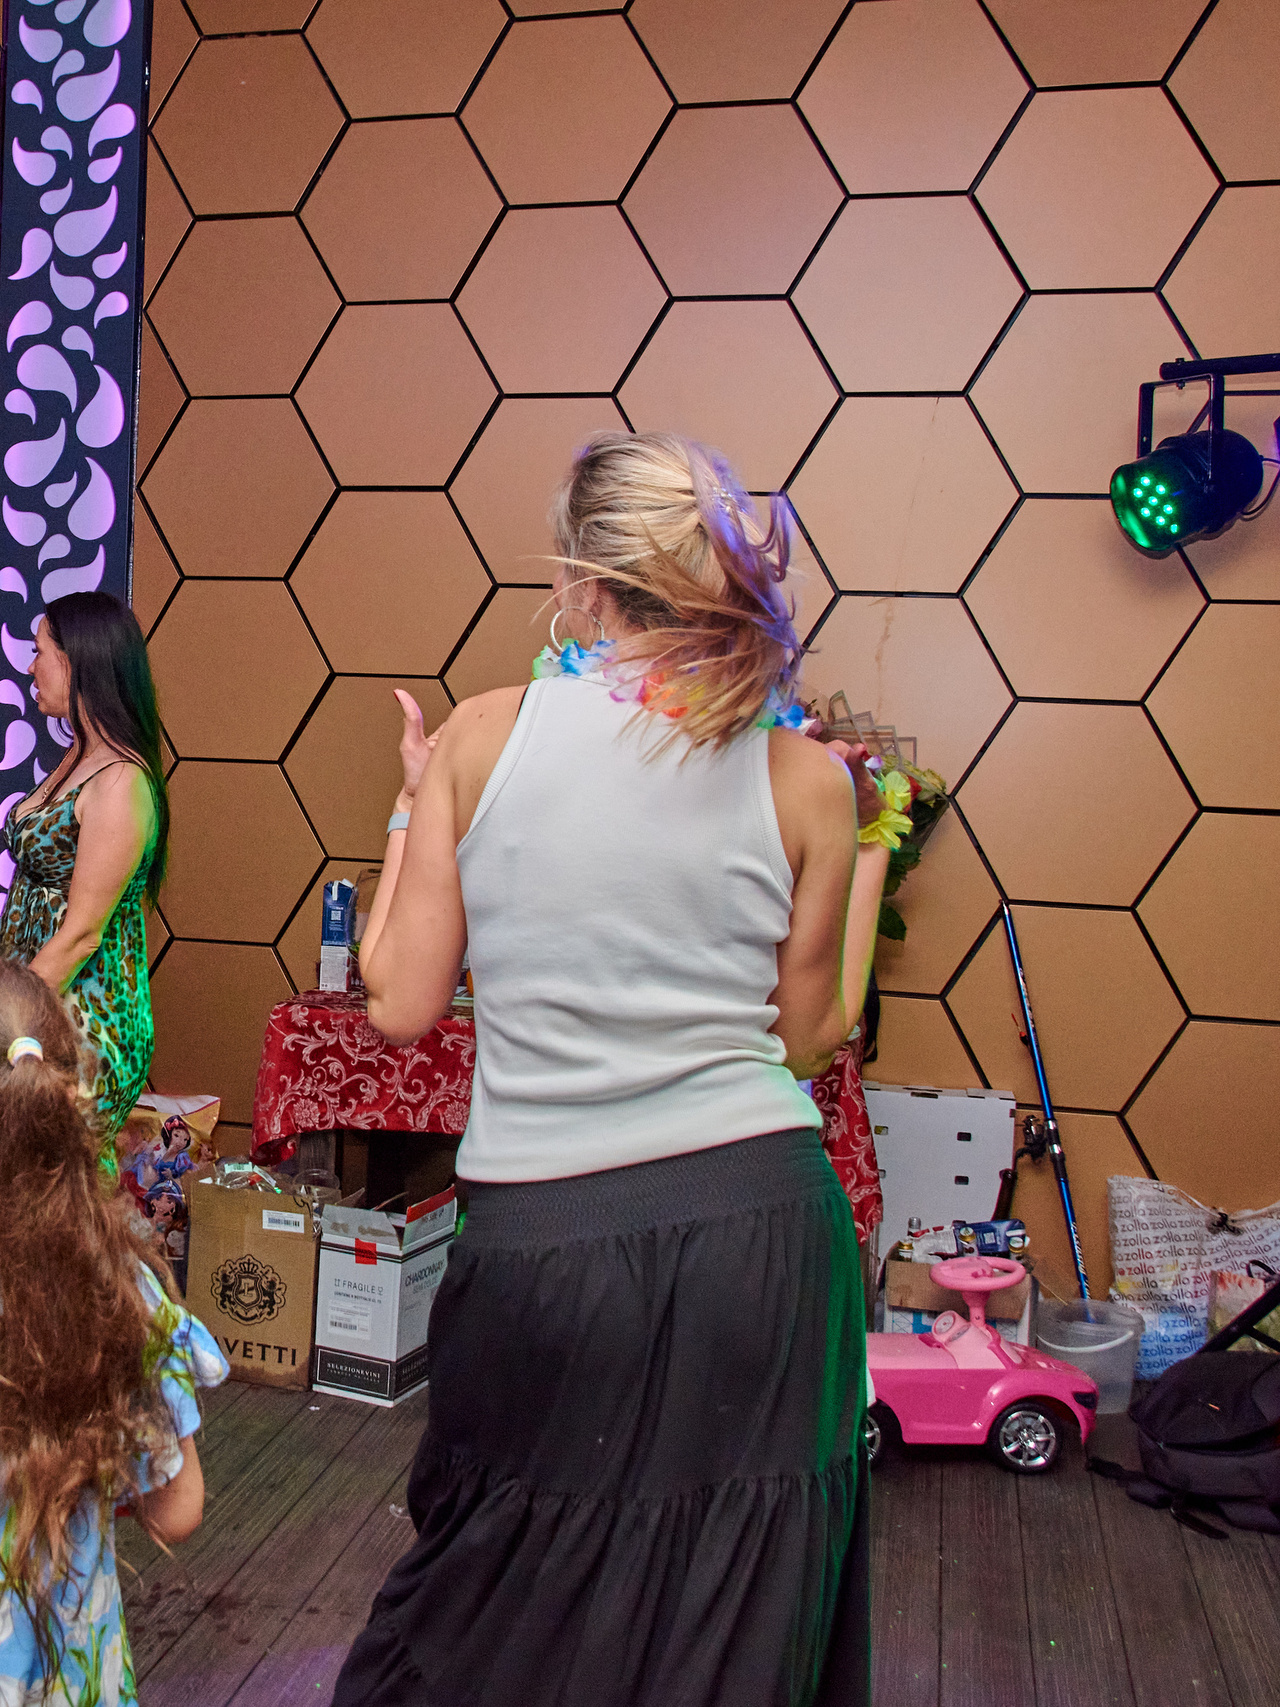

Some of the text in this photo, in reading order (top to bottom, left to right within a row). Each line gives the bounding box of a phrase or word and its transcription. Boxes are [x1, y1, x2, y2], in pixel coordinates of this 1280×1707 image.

[1118, 1205, 1145, 1218] zolla
[1148, 1205, 1172, 1216] zolla
[1121, 1216, 1204, 1232] zolla zolla zolla
[1123, 1233, 1151, 1247] zolla
[1153, 1231, 1181, 1244] zolla
[1183, 1229, 1202, 1242] zoll
[1126, 1248, 1153, 1260] zolla
[1156, 1245, 1184, 1258] zolla
[1210, 1238, 1236, 1254] zolla
[1237, 1234, 1264, 1246] zolla
[1127, 1262, 1155, 1275] zolla
[1214, 1248, 1242, 1264] zolla
[1243, 1243, 1272, 1256] zolla
[1191, 1271, 1210, 1284] zoll
[342, 1280, 376, 1294] FRAGILE
[1137, 1291, 1161, 1301] zolla
[1162, 1288, 1192, 1301] zolla
[1168, 1302, 1197, 1314] zolla
[1172, 1315, 1200, 1328] zolla
[1141, 1330, 1203, 1343] zolla zolla
[1142, 1345, 1173, 1357] zolla
[327, 1362, 380, 1378] SELEZIONEVINI
